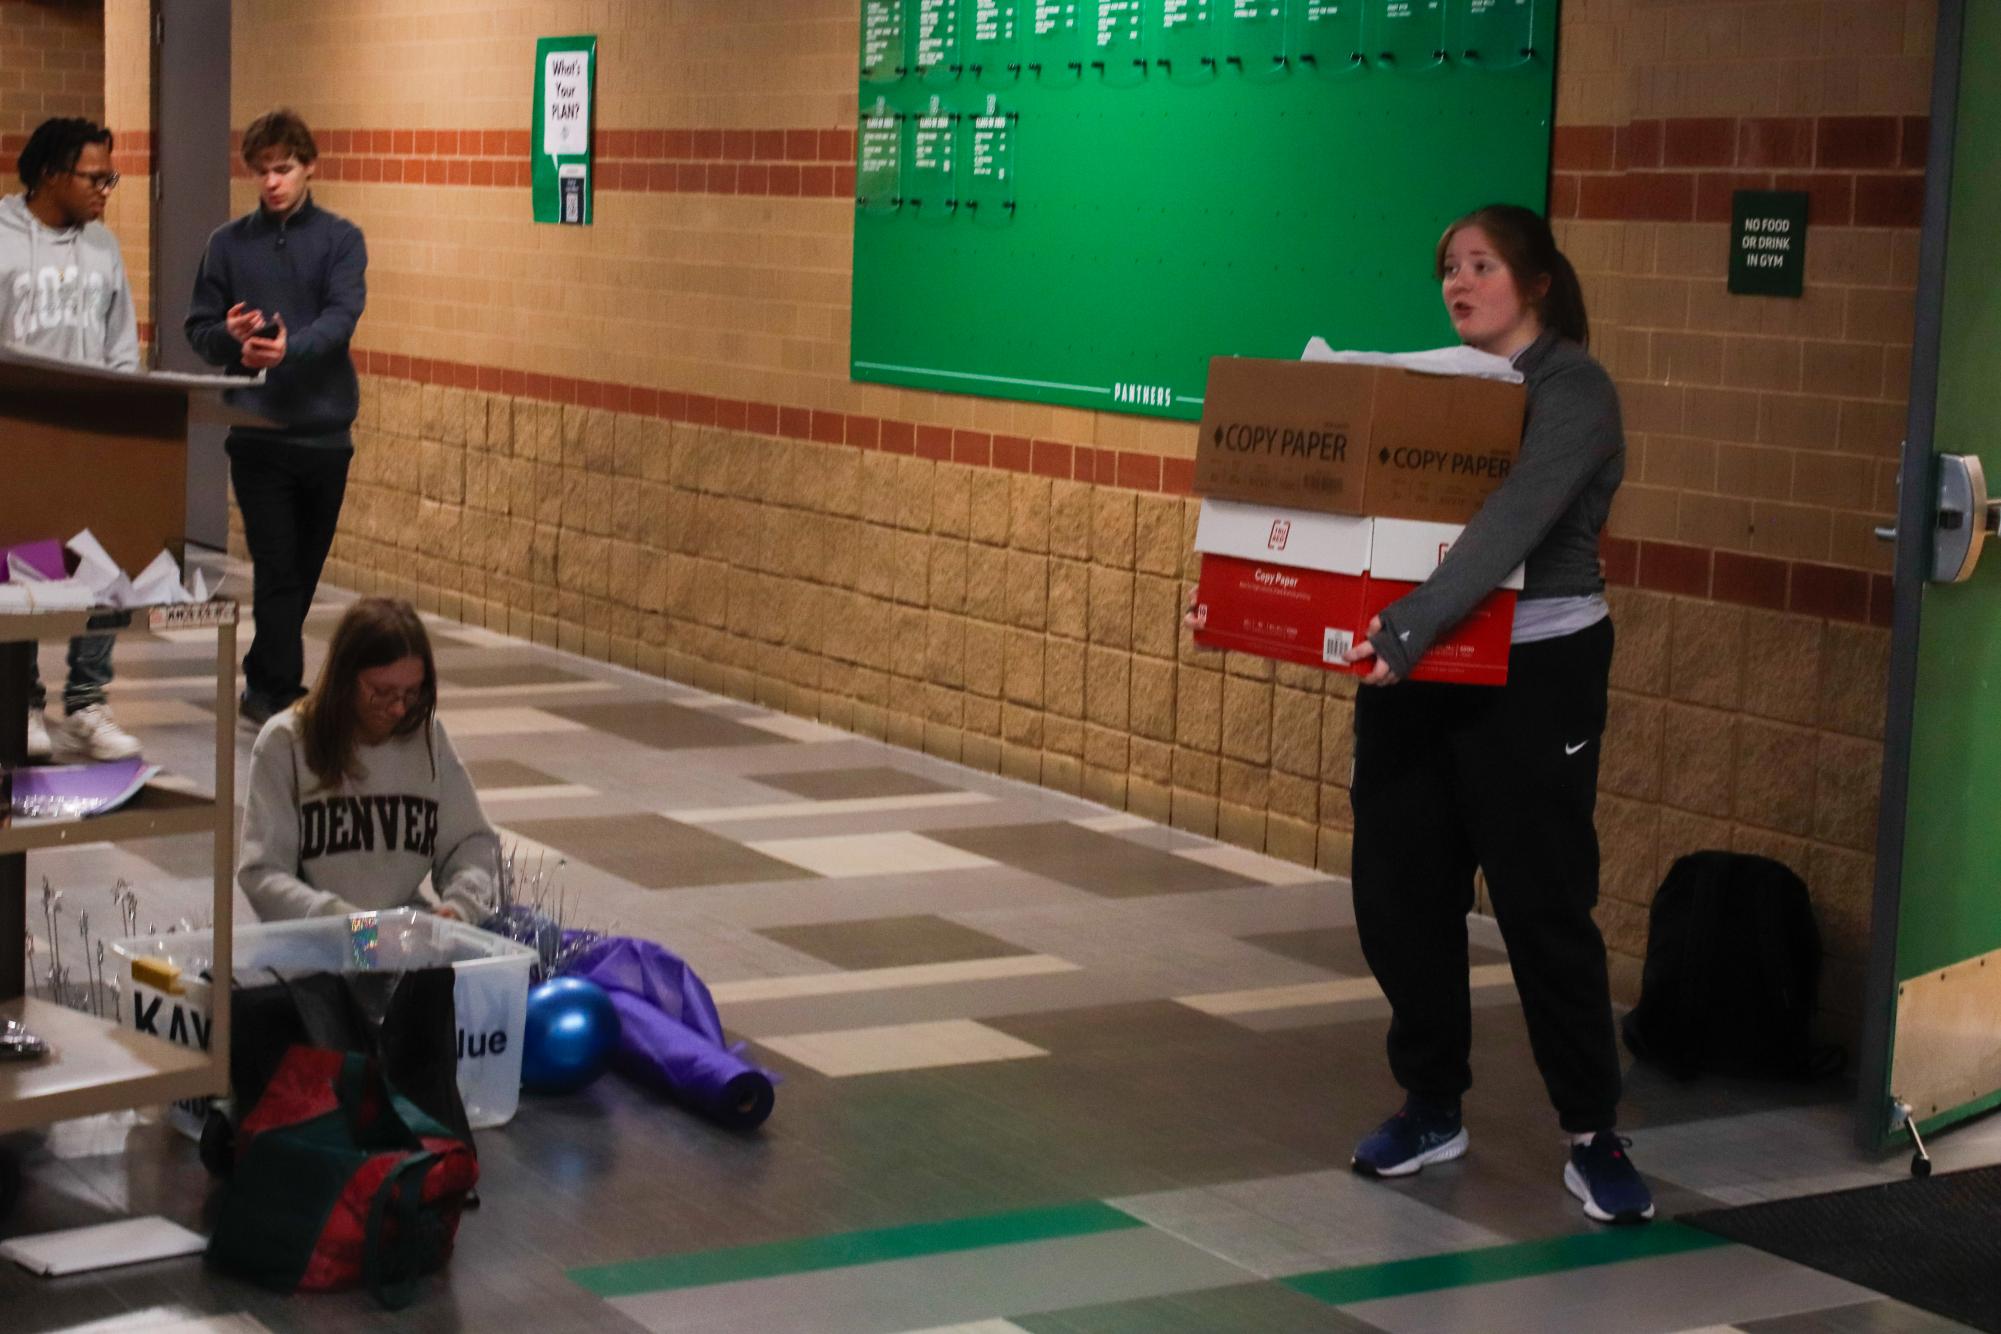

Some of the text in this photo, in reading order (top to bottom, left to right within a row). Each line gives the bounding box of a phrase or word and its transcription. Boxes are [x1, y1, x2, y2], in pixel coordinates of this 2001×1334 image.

[552, 60, 581, 76] What's
[555, 83, 576, 98] Your
[552, 103, 579, 120] PLAN?
[1745, 219, 1790, 232] NO FOOD
[1742, 236, 1791, 251] OR DRINK
[1746, 253, 1784, 268] IN GYM
[1114, 382, 1171, 407] PANTHERS
[1226, 423, 1347, 462] COPY PAPER
[1393, 447, 1511, 478] COPY PAPER
[1255, 568, 1298, 588] Copy Paper
[302, 795, 439, 860] DENVER
[458, 1028, 507, 1059] lue
